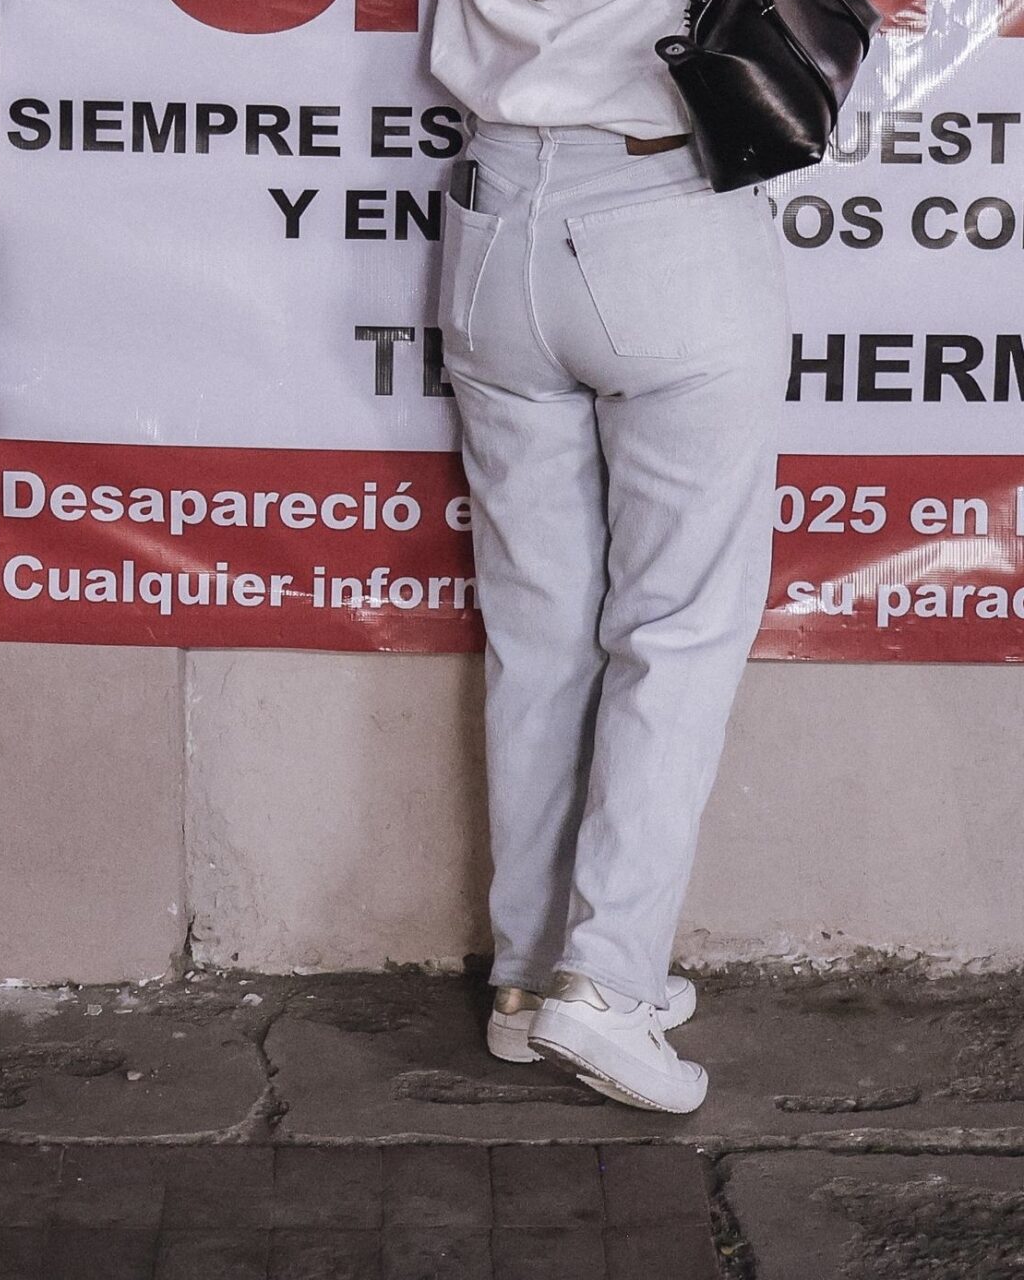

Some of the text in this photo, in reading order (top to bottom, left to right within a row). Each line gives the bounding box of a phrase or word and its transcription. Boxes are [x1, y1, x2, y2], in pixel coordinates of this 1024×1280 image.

[7, 98, 1022, 165] SIEMPRE ES UEST
[267, 188, 319, 239] Y
[768, 195, 884, 250] OS
[911, 196, 1024, 251] CO
[1, 470, 422, 536] Desapareció
[773, 485, 887, 534] 025
[910, 497, 989, 535] en
[2, 555, 294, 616] Cualquier
[786, 581, 854, 616] su
